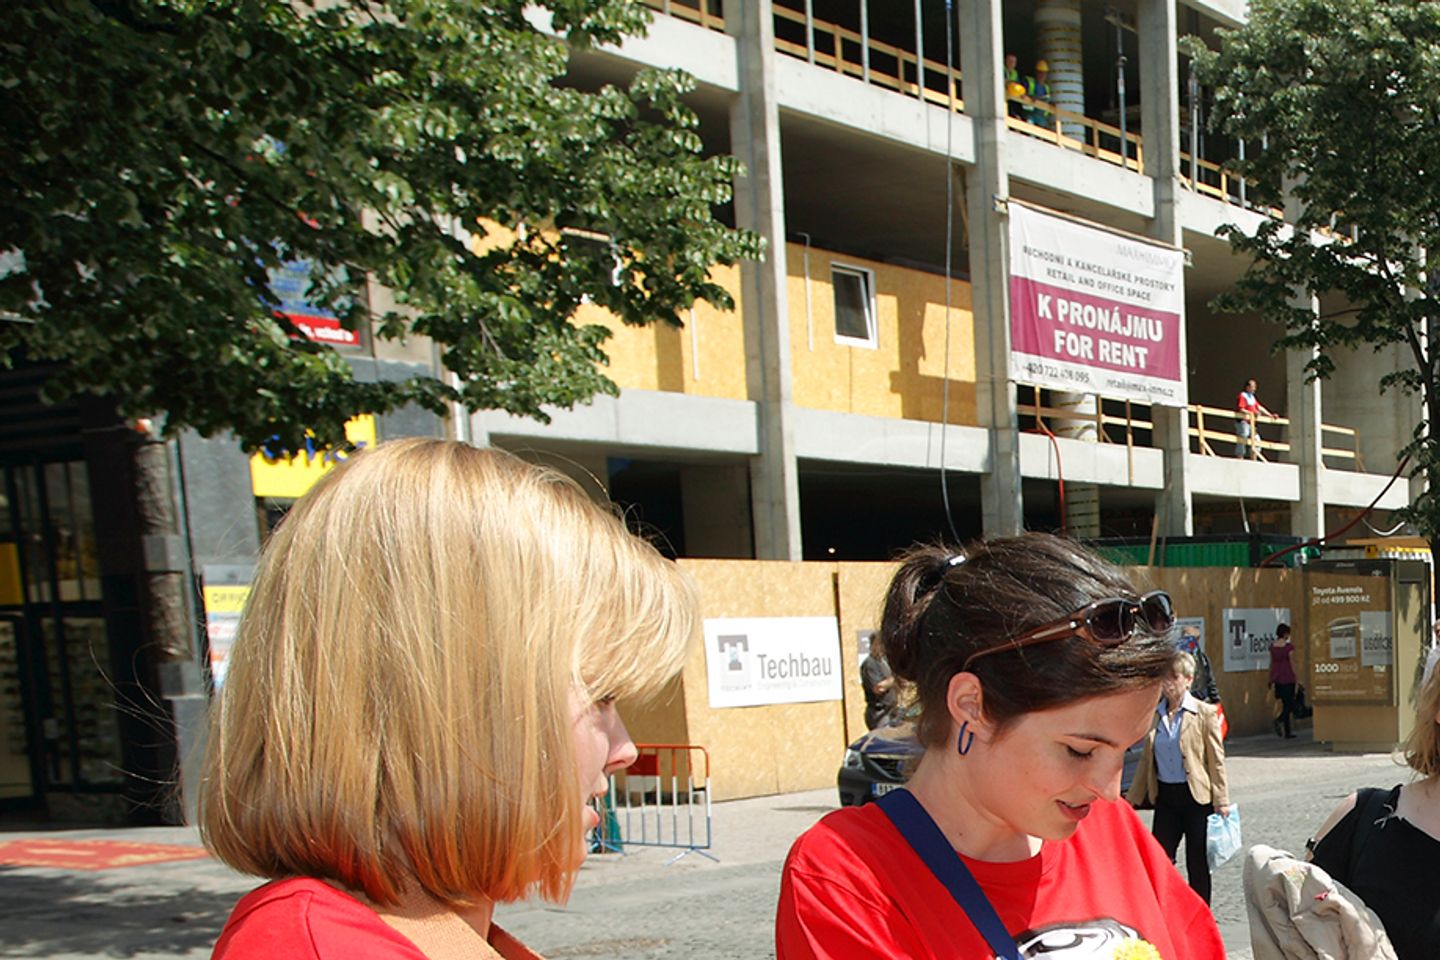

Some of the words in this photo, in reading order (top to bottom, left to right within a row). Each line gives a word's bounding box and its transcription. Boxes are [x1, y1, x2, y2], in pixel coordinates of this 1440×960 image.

[1046, 267, 1076, 284] RETAIL
[1078, 276, 1095, 289] AND
[1098, 280, 1124, 296] OFFICE
[1126, 286, 1151, 302] SPACE
[1038, 294, 1053, 320] K
[1057, 298, 1163, 342] PRONÁJMU
[1054, 330, 1094, 360] FOR
[1099, 339, 1148, 369] RENT
[1248, 632, 1274, 653] Tech
[756, 652, 832, 679] Techbau
[1315, 663, 1340, 673] 1000
